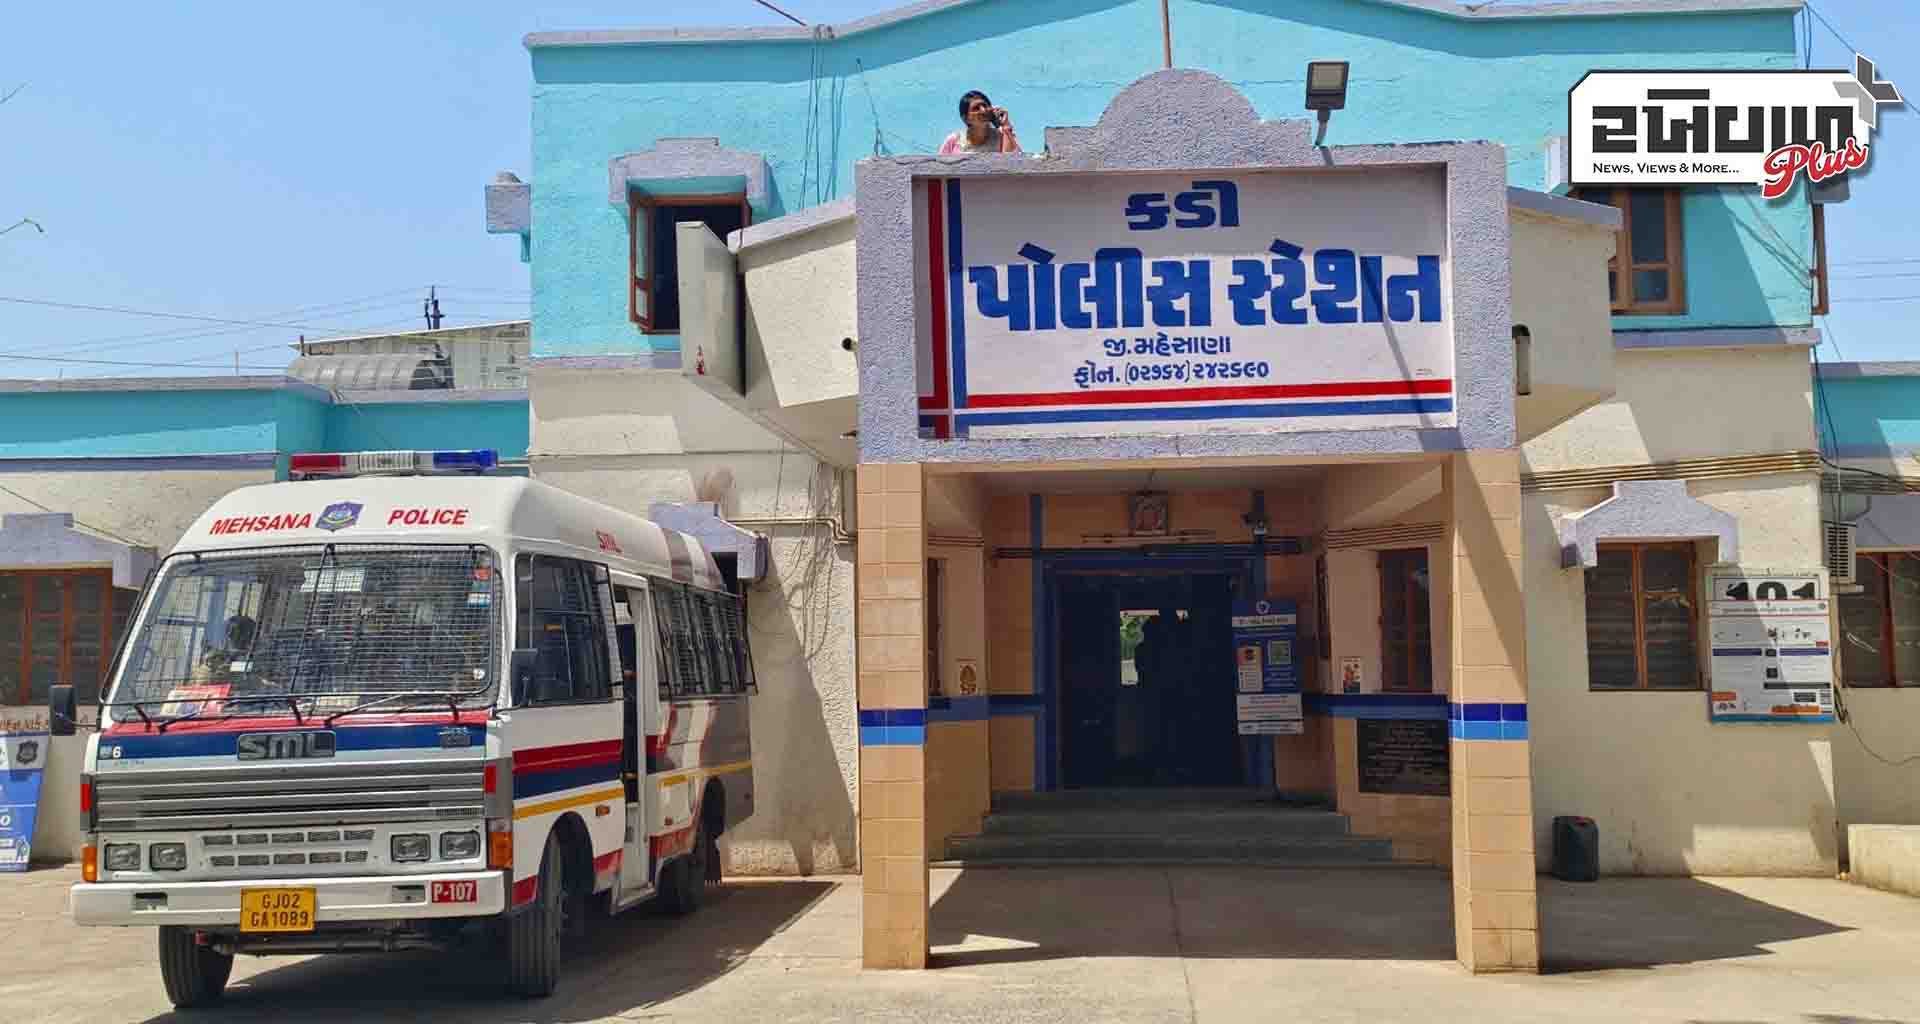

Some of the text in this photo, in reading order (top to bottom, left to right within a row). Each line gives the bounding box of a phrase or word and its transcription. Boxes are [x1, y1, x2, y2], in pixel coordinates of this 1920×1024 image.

[1124, 180, 1239, 231] કડી
[968, 239, 1442, 330] પોલીસ સ્ટેશન
[209, 508, 469, 535] MEHSANA POLICE
[262, 893, 300, 909] GJ02
[432, 880, 475, 901] P-107
[251, 911, 308, 927] GA1089
